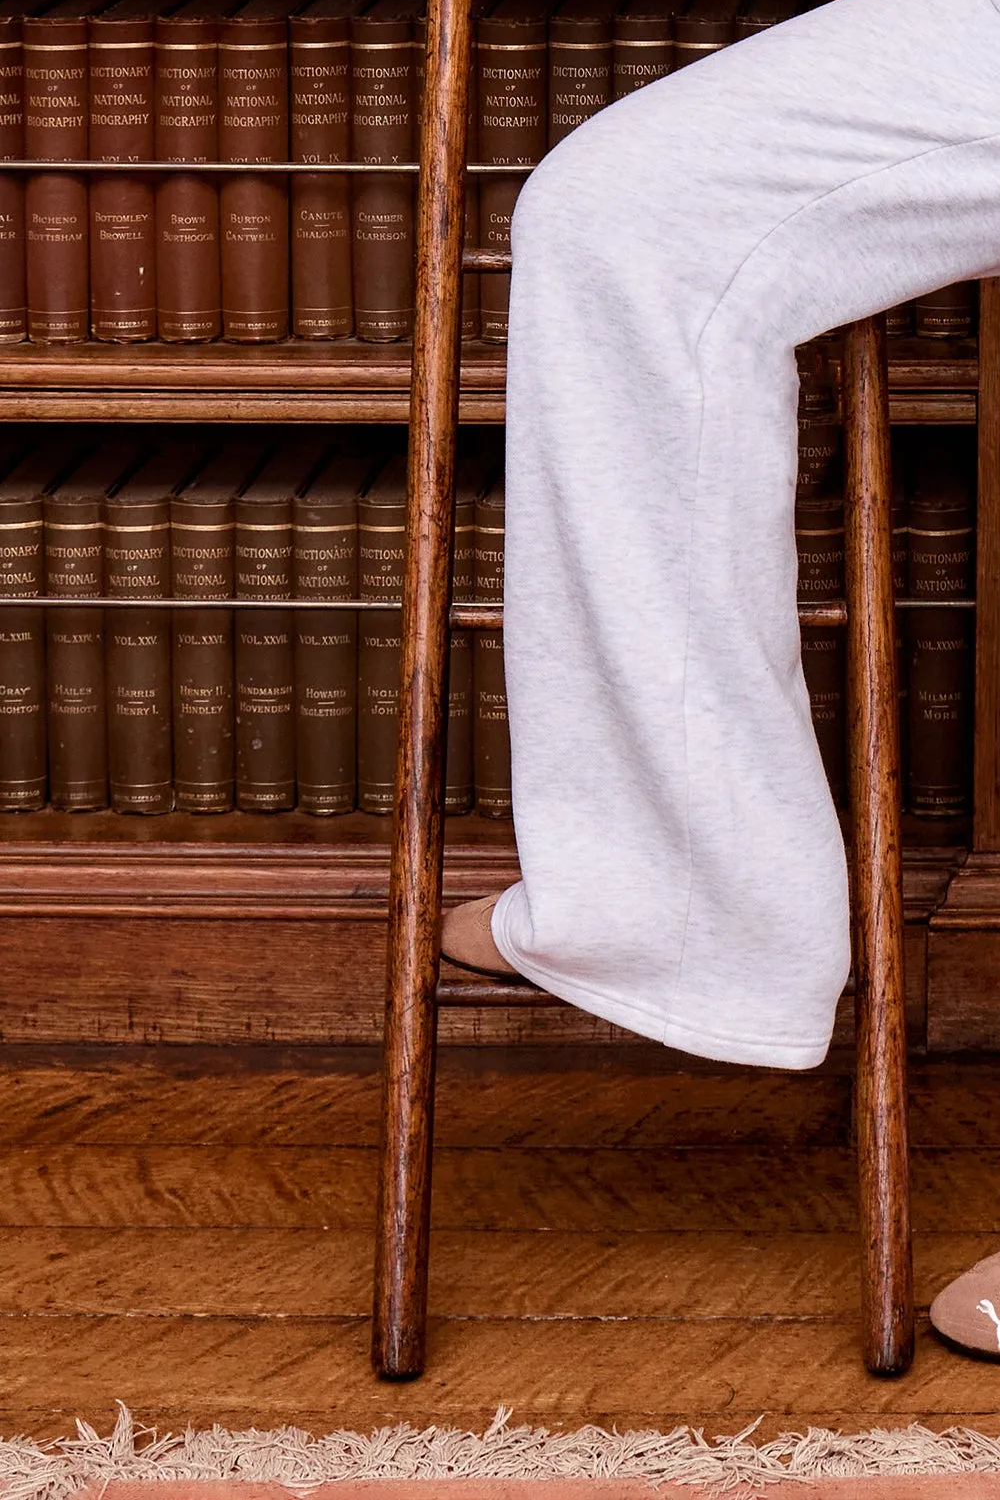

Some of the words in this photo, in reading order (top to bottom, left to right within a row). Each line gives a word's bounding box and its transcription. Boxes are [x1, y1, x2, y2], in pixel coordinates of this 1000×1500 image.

[26, 68, 85, 79] DICTIONARY
[91, 66, 150, 78] DICTIONARY
[160, 67, 216, 79] DICTIONARY
[223, 68, 281, 79] DICTIONARY
[291, 65, 348, 77] DICTIONARY
[353, 67, 409, 78] DICTIONARY
[483, 68, 540, 79] DICTIONARY
[553, 66, 608, 78] DICTIONARY
[30, 96, 80, 108] NATIONAL
[94, 94, 146, 105] NATIONAL
[162, 95, 212, 106] NATIONAL
[227, 96, 278, 107] NATIONAL
[295, 93, 344, 104] NATIONAL
[356, 95, 406, 106] NATIONAL
[486, 96, 537, 107] NATIONAL
[556, 94, 606, 105] NATIONAL
[28, 116, 83, 127] BIOGRAPHY
[92, 114, 149, 125] BIOGRAPHY
[160, 115, 215, 126] BIOGRAPHY
[224, 115, 280, 127] BIOGRAPHY
[293, 113, 348, 125] BIOGRAPHY
[354, 114, 408, 126] BIOGRAPHY
[483, 116, 539, 127] BIOGRAPHY
[32, 214, 77, 224] BICHENO
[95, 212, 148, 222] BOTTOMLEY
[171, 214, 206, 224] BROWN
[231, 214, 271, 223] BURTON
[100, 230, 144, 240] BROWELL
[106, 548, 163, 560] DICTIONARY
[110, 575, 160, 586] NATIONAL
[239, 574, 288, 585] NATIONAL
[118, 687, 155, 698] HARRIS
[180, 686, 213, 696] HENRY
[117, 704, 150, 715] HENRY
[182, 704, 223, 714] HINDLEY
